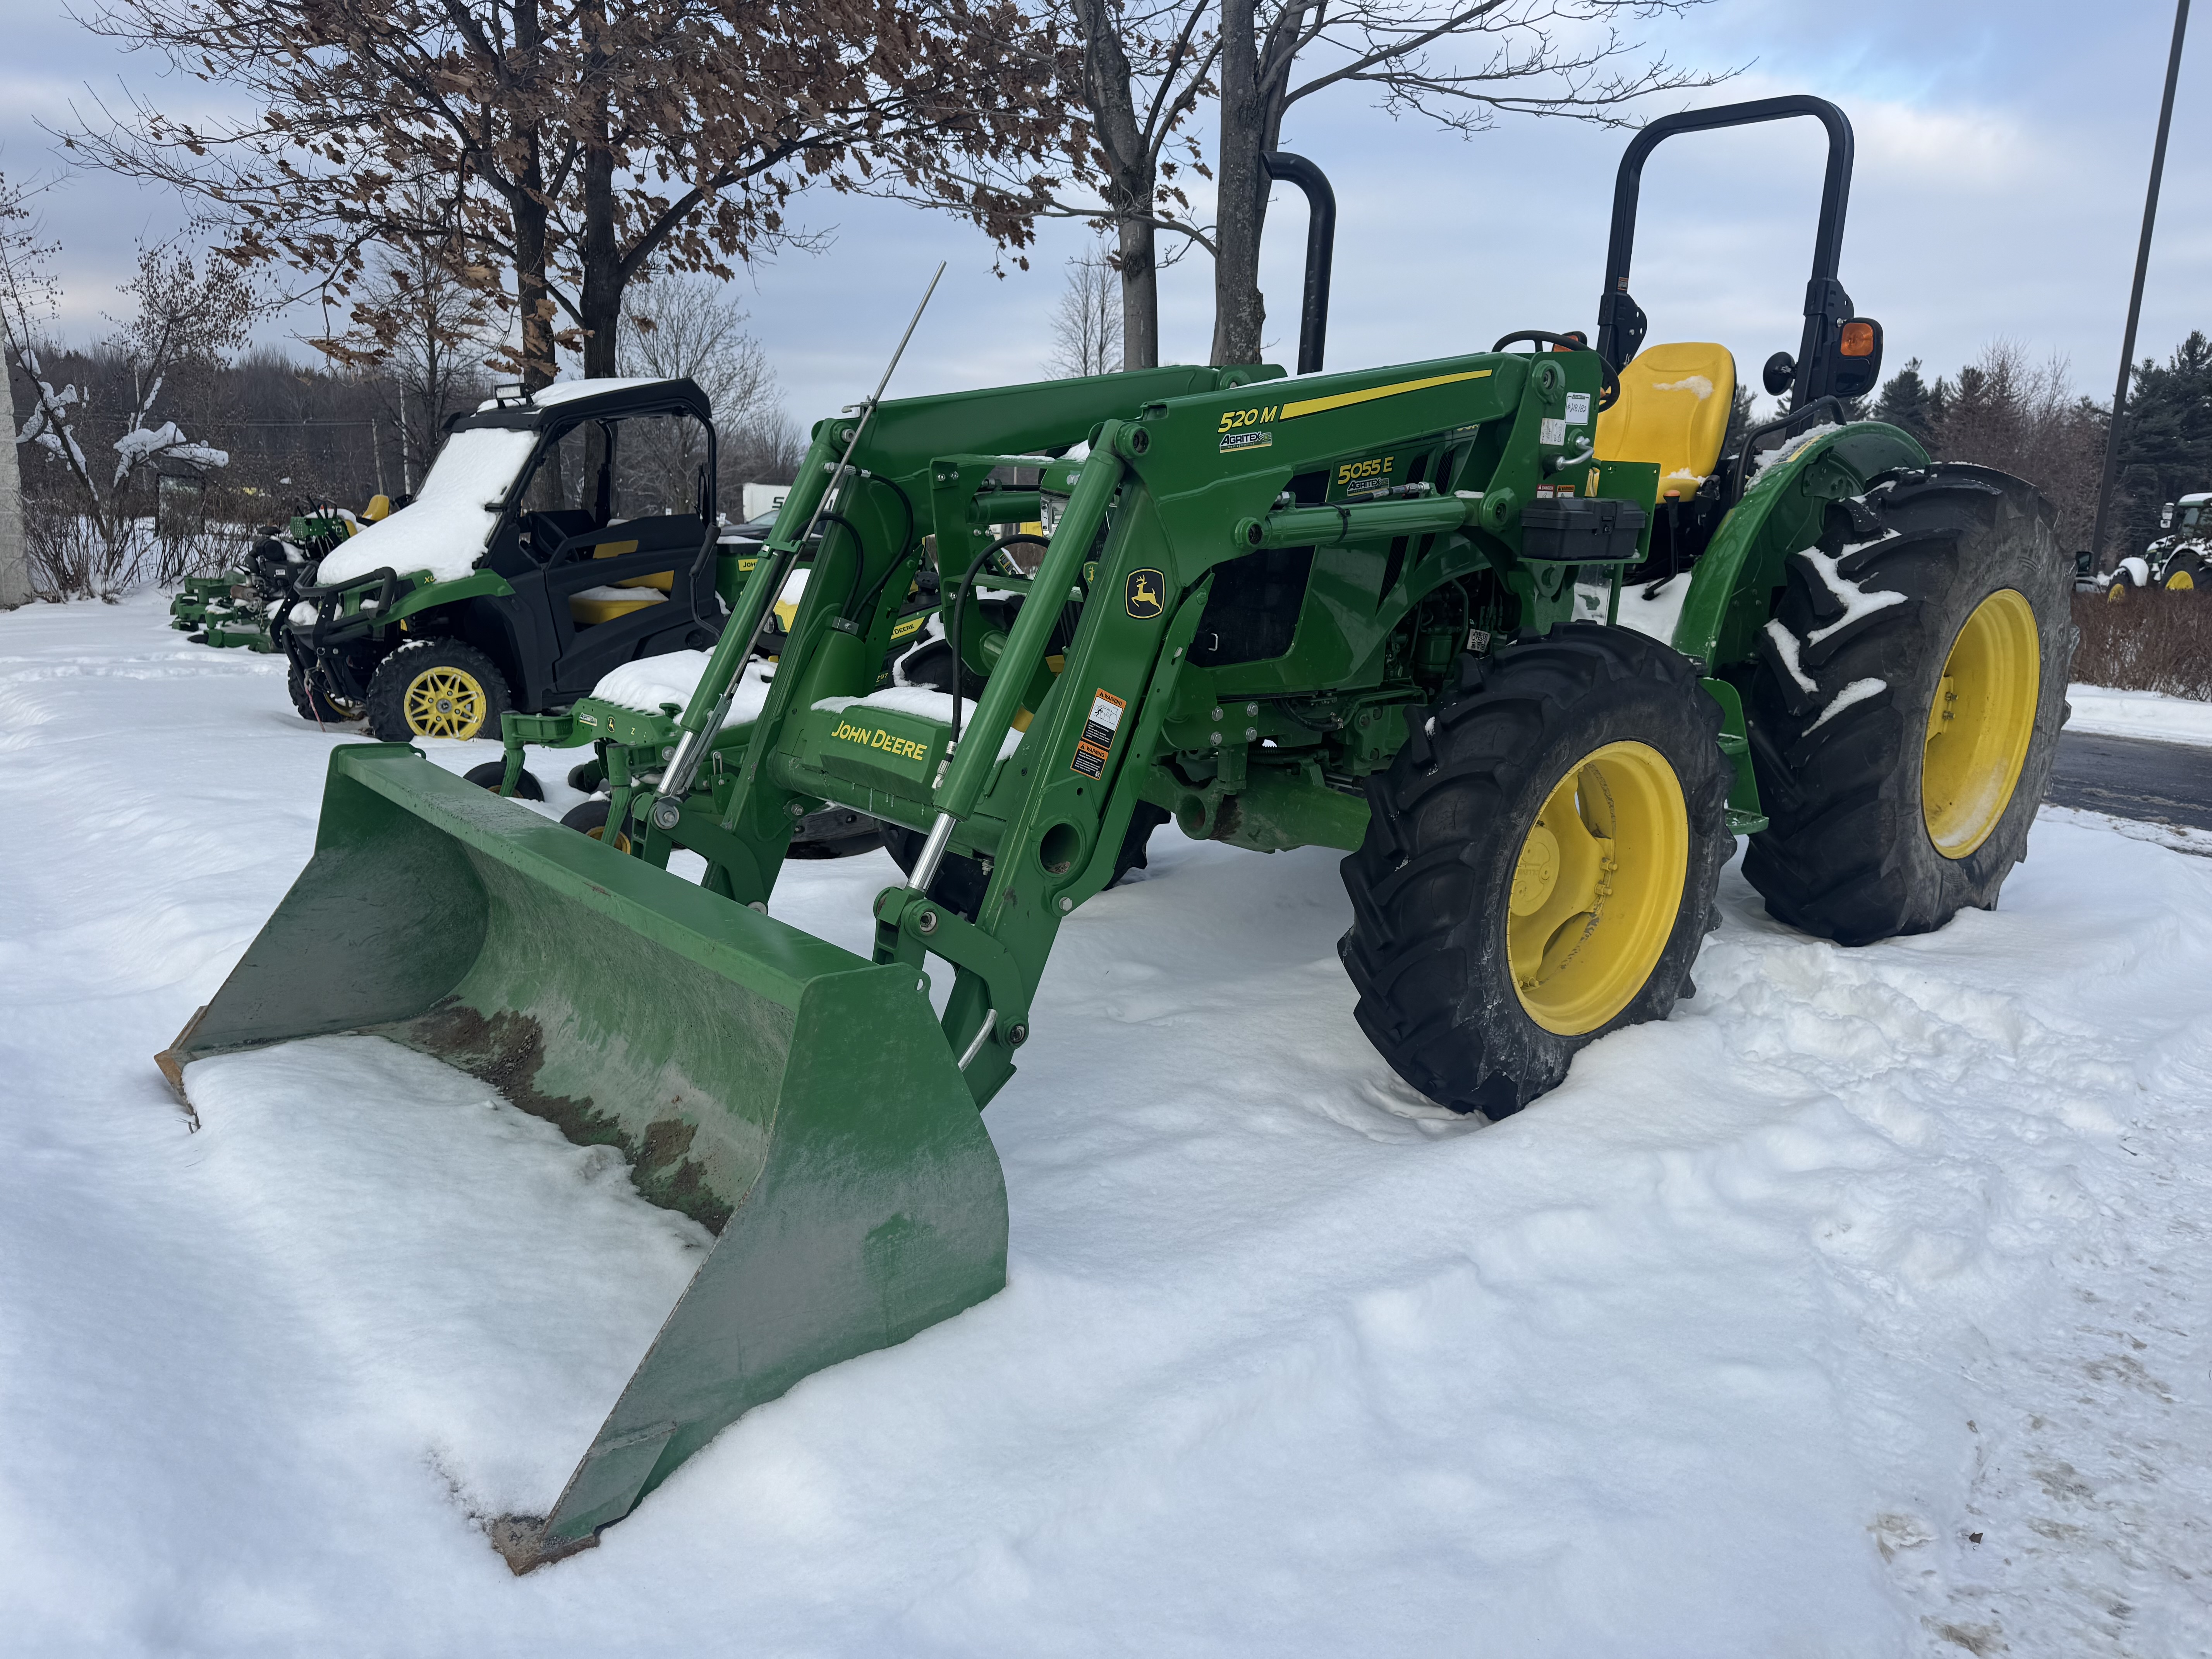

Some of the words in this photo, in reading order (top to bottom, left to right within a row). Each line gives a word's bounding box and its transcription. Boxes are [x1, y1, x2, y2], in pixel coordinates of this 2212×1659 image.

[1218, 409, 1258, 433] 520
[1260, 405, 1278, 423] M
[1221, 433, 1261, 445] AGRITEX
[1338, 459, 1381, 484] 5055
[1383, 456, 1394, 472] E
[1348, 479, 1380, 490] AGRITEX
[894, 624, 914, 635] DEERE
[1104, 694, 1122, 706] WARNING
[831, 720, 872, 745] JOHN
[871, 729, 927, 761] DEERE
[1086, 746, 1105, 757] WARNING
